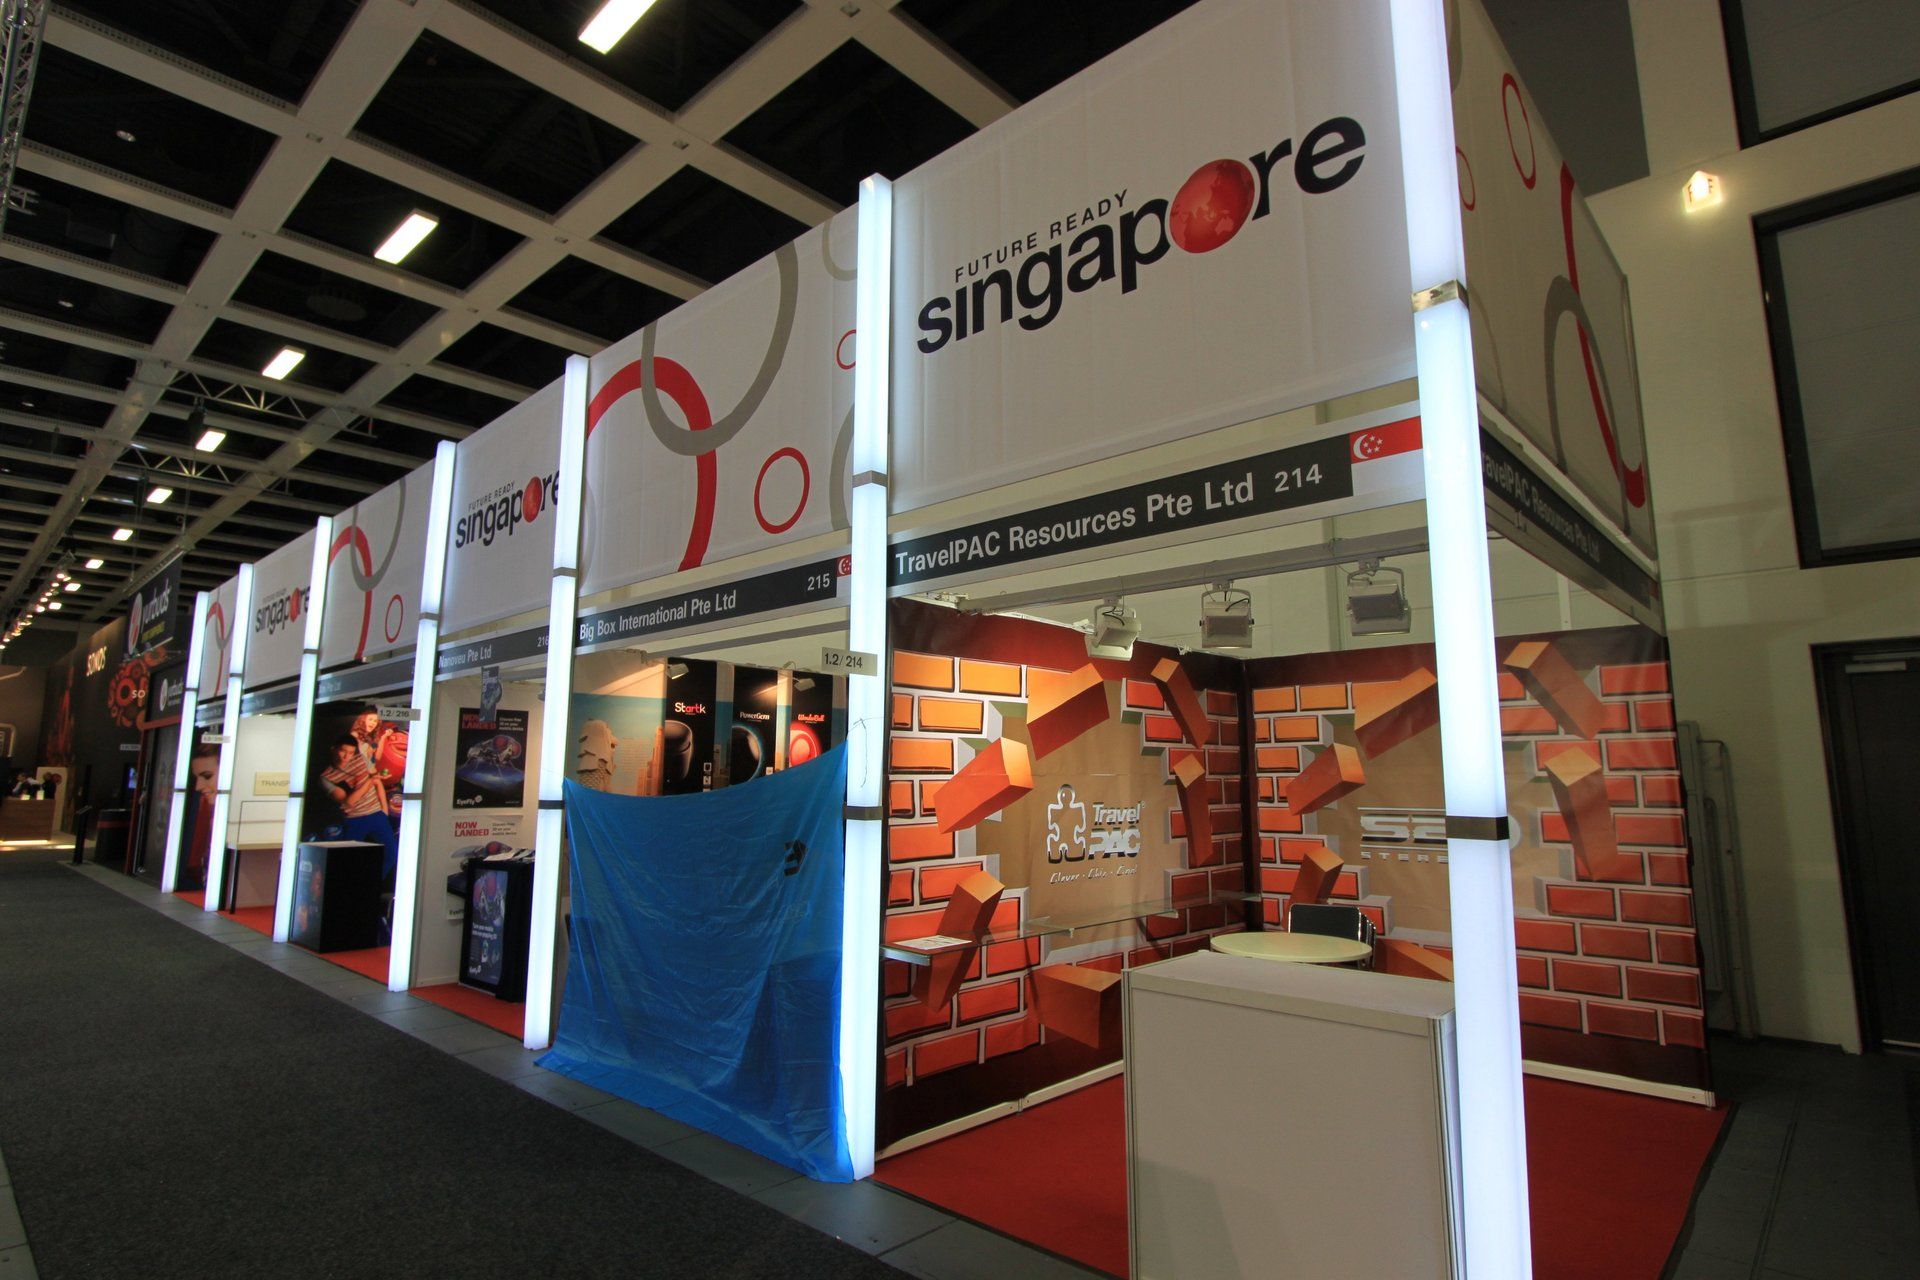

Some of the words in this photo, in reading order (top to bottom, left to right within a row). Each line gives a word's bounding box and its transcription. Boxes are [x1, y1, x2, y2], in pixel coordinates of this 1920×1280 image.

[916, 116, 1367, 354] singapore
[955, 232, 1039, 283] FUTURE
[1050, 189, 1128, 240] READY
[468, 492, 492, 513] FUTURE
[494, 481, 515, 499] READY
[895, 532, 1001, 577] TravelPAC
[1008, 506, 1136, 553] Resources
[1146, 492, 1194, 524] Pte
[1204, 472, 1254, 511] Ltd
[1274, 462, 1323, 494] 214
[579, 622, 594, 642] Big
[597, 618, 616, 635] Box
[619, 600, 687, 632] International
[691, 597, 711, 616] Pte
[715, 589, 737, 612] Ltd
[807, 573, 830, 592] 215
[467, 649, 479, 663] Pte
[480, 644, 492, 660] Ltd
[846, 655, 863, 669] 214
[674, 701, 707, 715] Startk
[455, 821, 478, 830] NOW
[1092, 801, 1141, 826] Travel
[454, 828, 489, 838] LANDED
[1088, 825, 1141, 861] PAC
